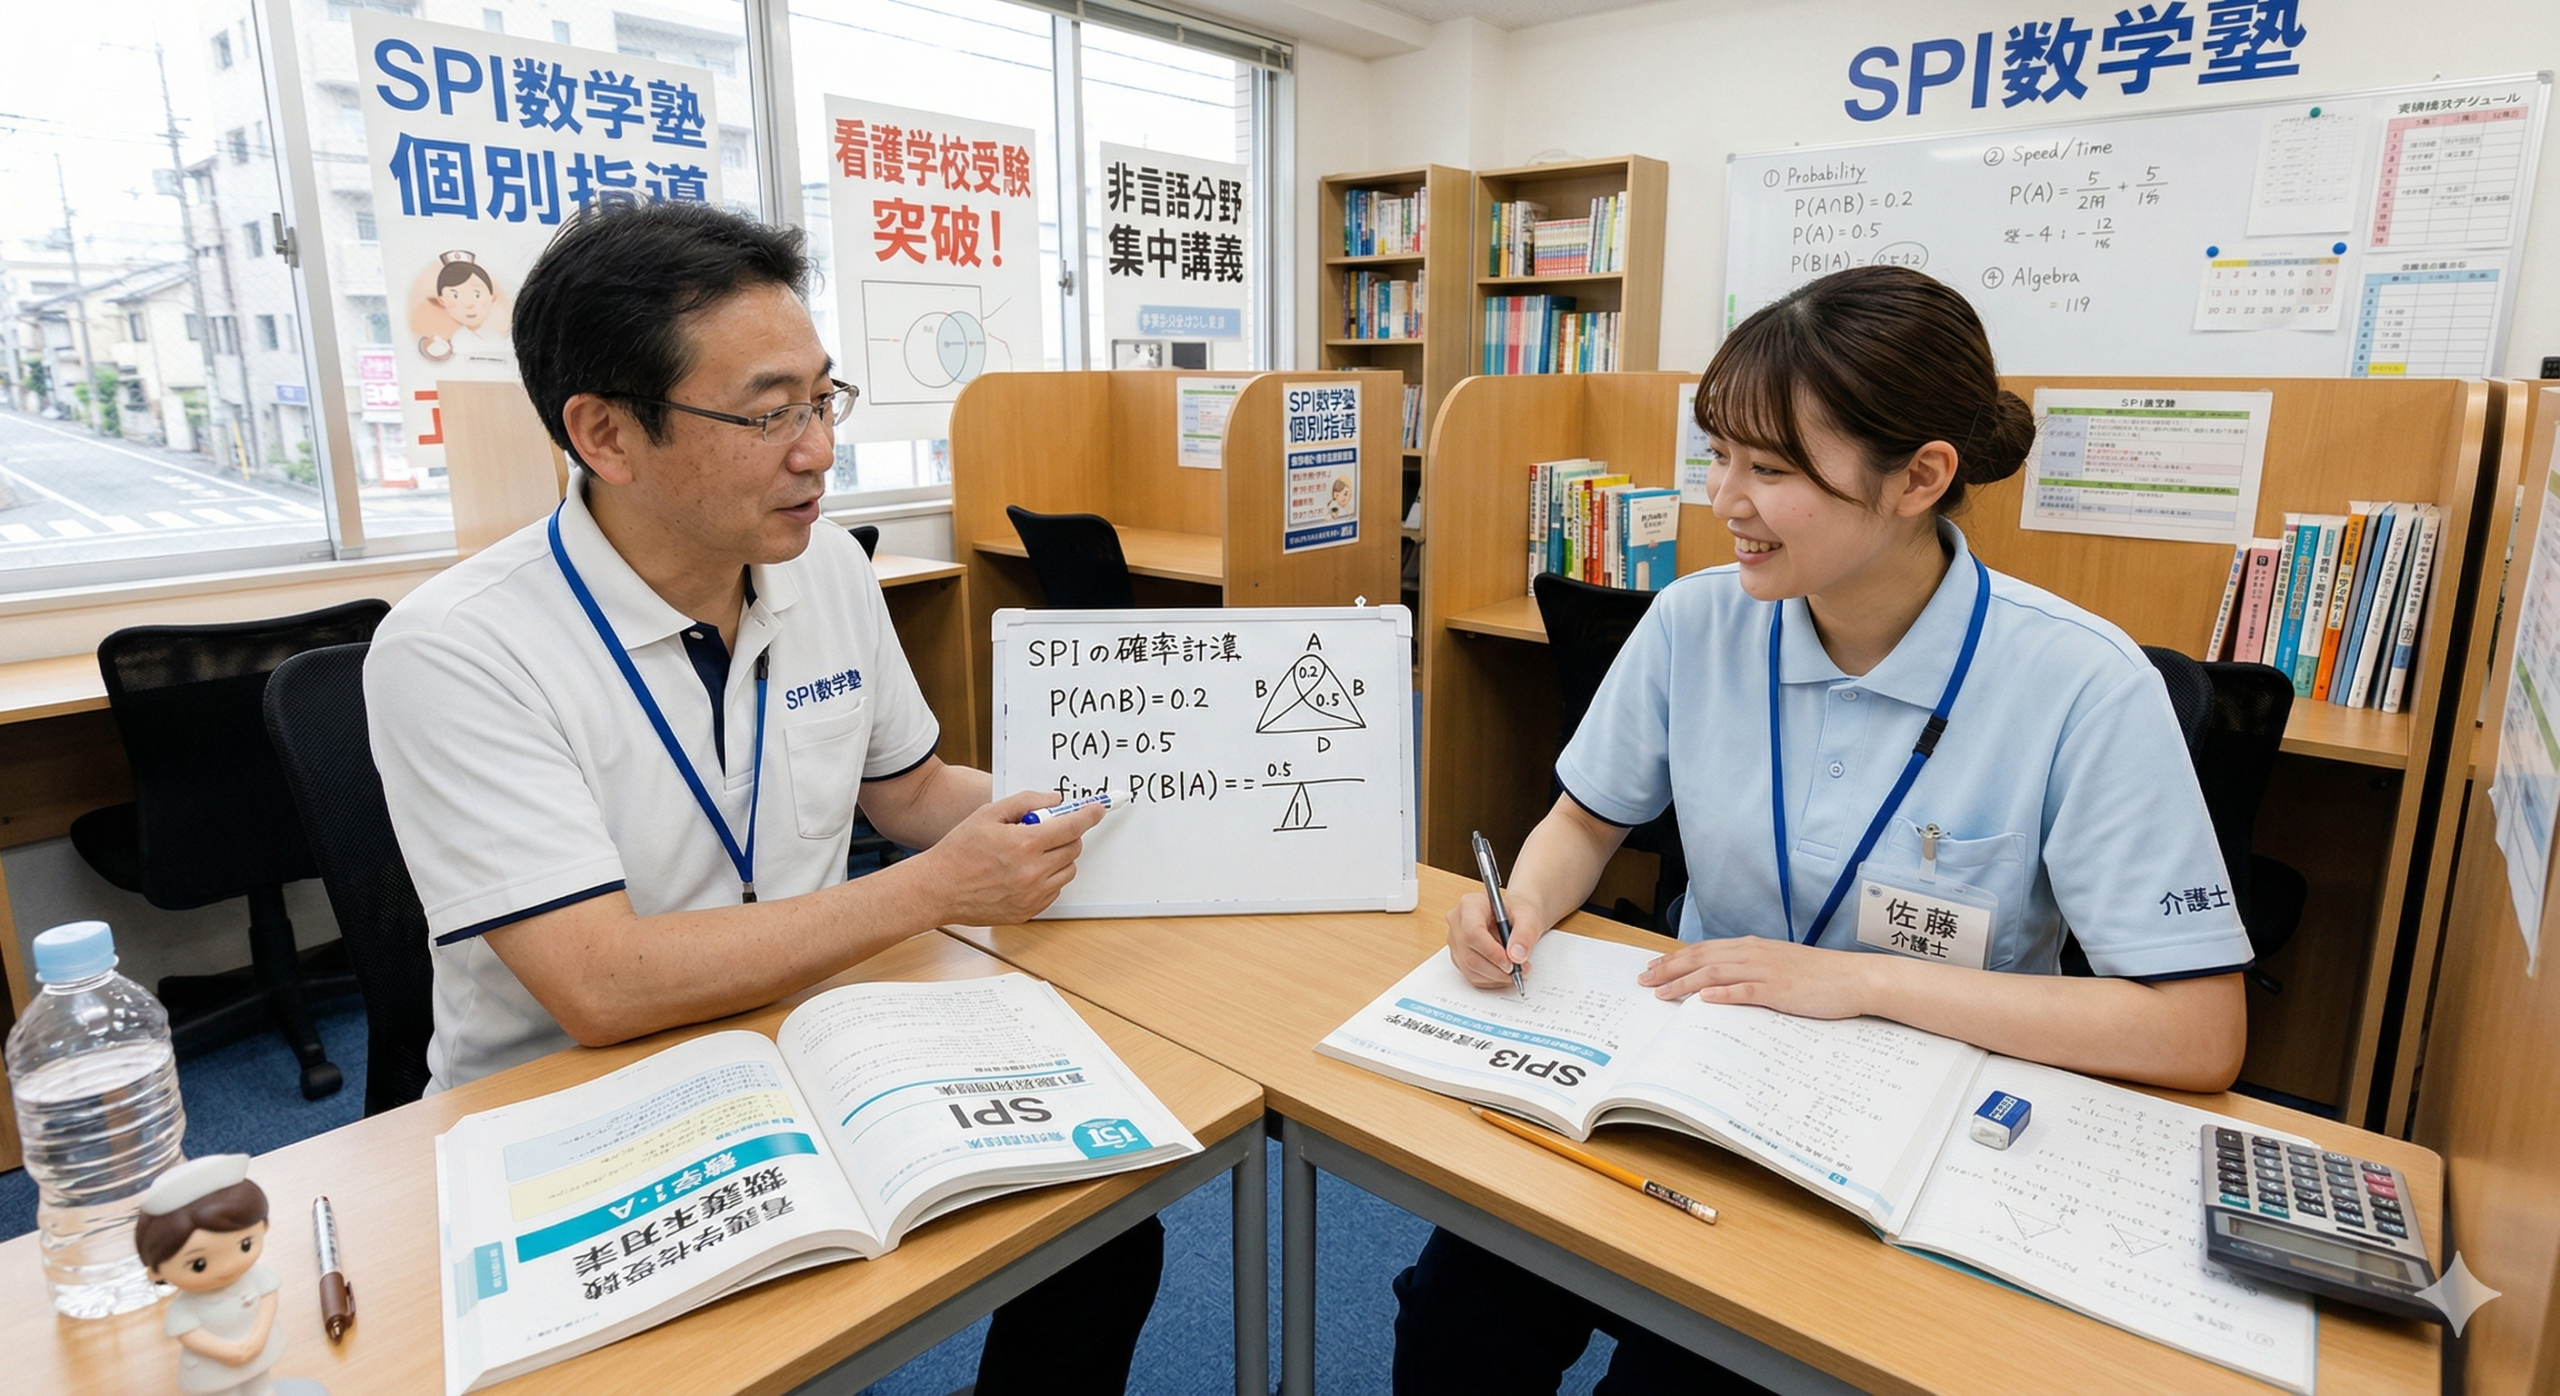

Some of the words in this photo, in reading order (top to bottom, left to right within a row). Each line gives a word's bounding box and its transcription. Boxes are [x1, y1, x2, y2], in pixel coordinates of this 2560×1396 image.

[1844, 0, 2307, 122] SPI数学塾
[374, 38, 707, 149] SPI数学塾
[834, 118, 1031, 199] 看護学校受験
[1787, 161, 1867, 186] Probability
[1107, 161, 1242, 225] 非言語分野
[873, 197, 1003, 269] 突破！
[1108, 223, 1244, 284] 集中講義
[2011, 266, 2080, 292] Algebra
[1289, 388, 1356, 413] SPI数学塾
[1289, 413, 1357, 444] 個別指導
[1305, 633, 1322, 651] A
[1299, 665, 1319, 680] 0.2
[785, 669, 862, 710] SPI数学塾
[1255, 679, 1268, 699] B
[1315, 691, 1340, 708] 0.5
[1352, 679, 1366, 697] B
[1052, 730, 1176, 760] P(A)=0.5
[1317, 736, 1331, 753] D
[1267, 762, 1292, 777] 0.5
[1053, 775, 1109, 801] find
[2159, 884, 2231, 916] 介護士
[1885, 897, 1959, 940] 佐藤
[1891, 930, 1949, 959] 介護士
[1488, 1049, 1587, 1087] SPI3
[948, 1097, 1053, 1129] SPI
